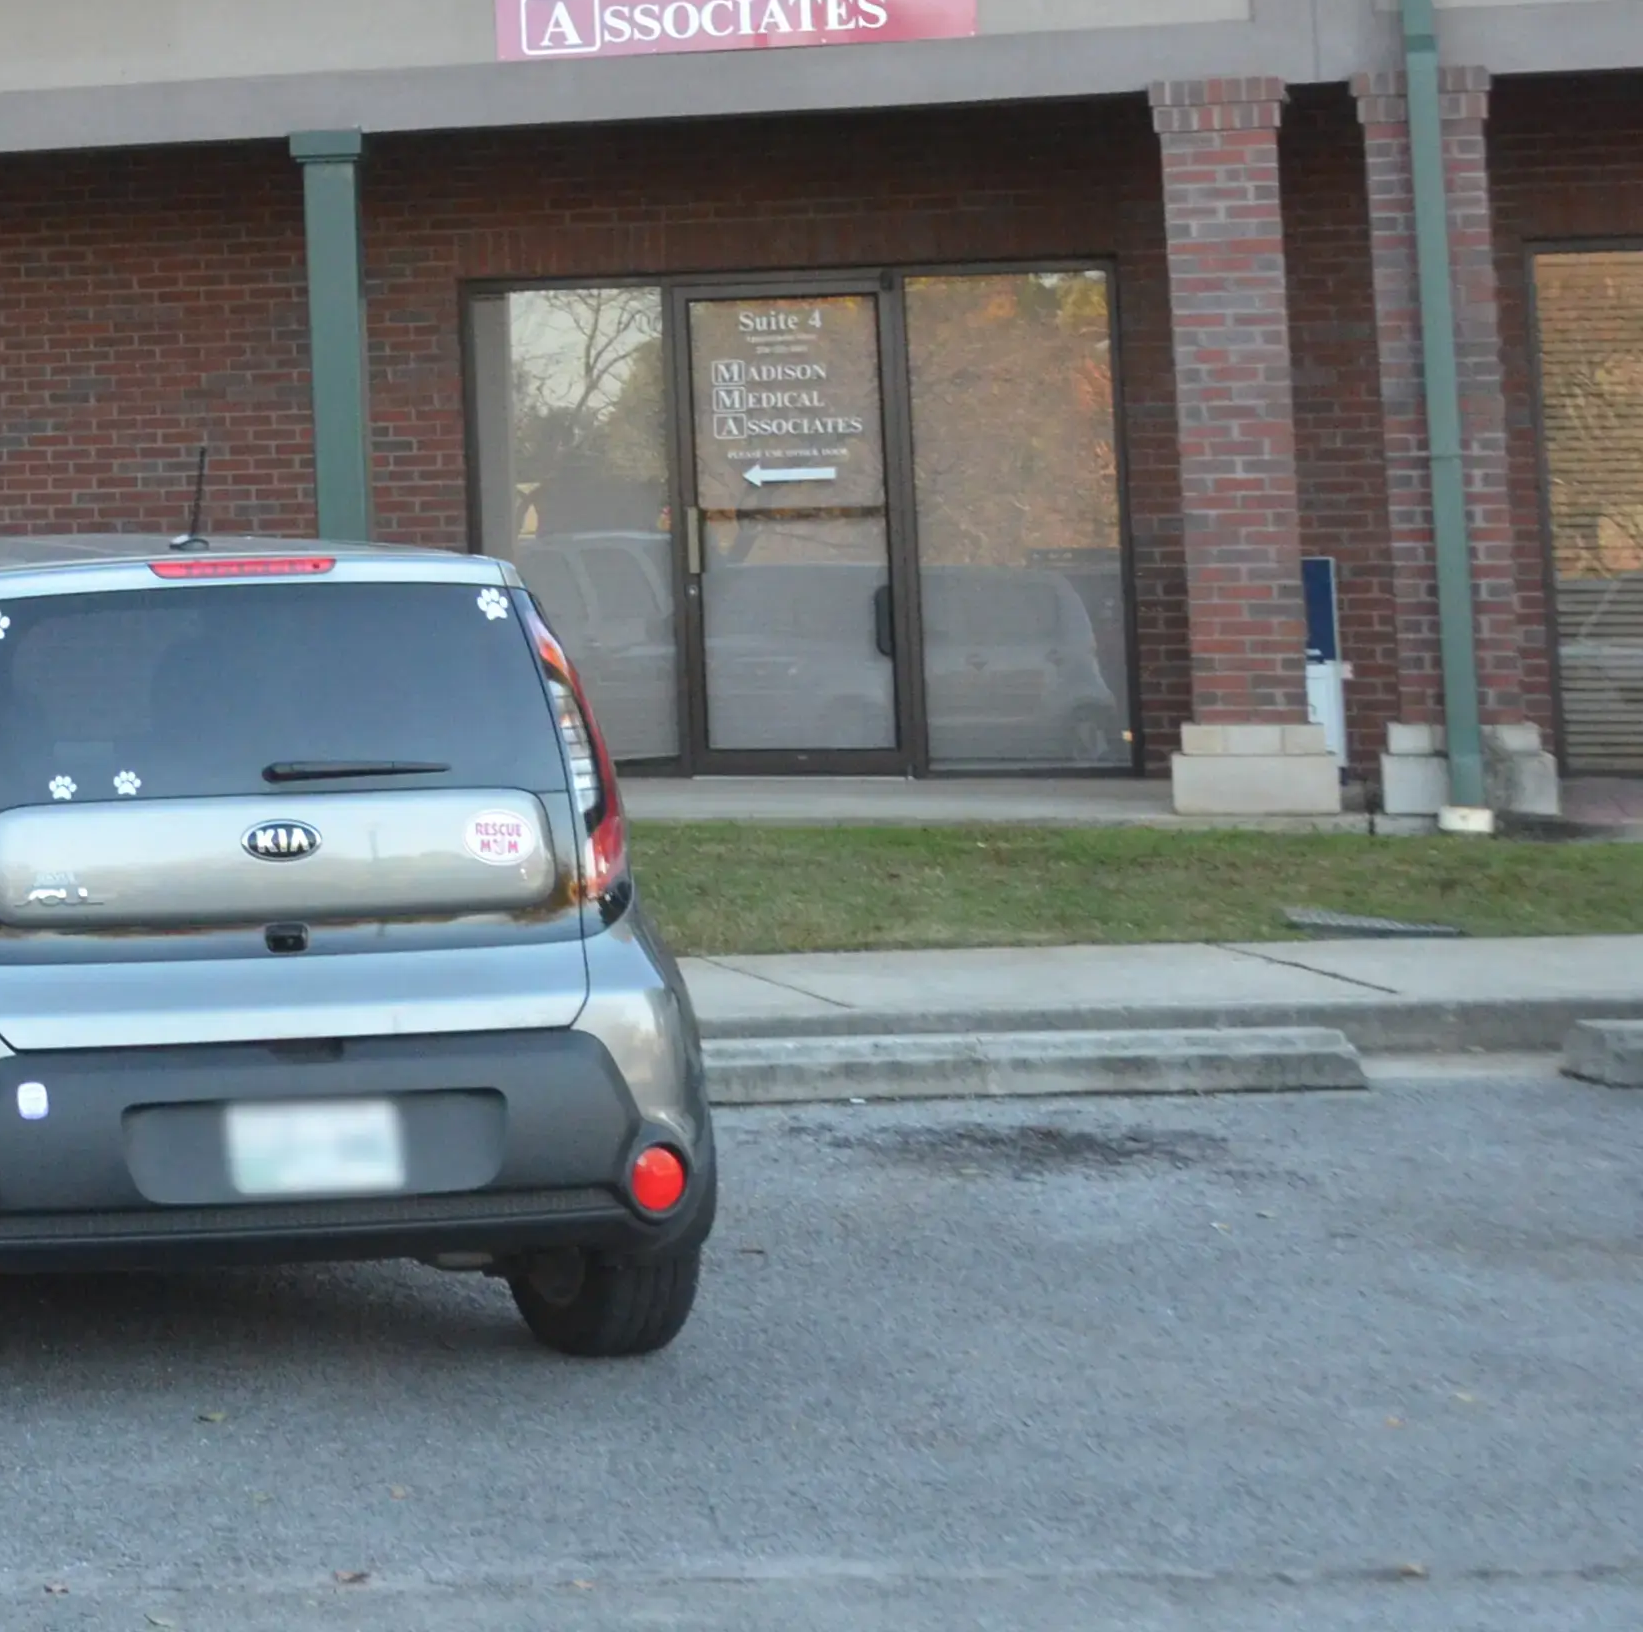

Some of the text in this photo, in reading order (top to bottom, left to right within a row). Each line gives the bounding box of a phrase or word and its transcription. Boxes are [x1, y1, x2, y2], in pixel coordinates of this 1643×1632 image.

[738, 308, 822, 332] Suite 4
[716, 362, 828, 384] MADISON
[717, 390, 825, 410] MEDICAL
[720, 416, 863, 436] ASSOCIATES
[255, 827, 310, 853] KIA
[475, 822, 523, 838] RESCUE
